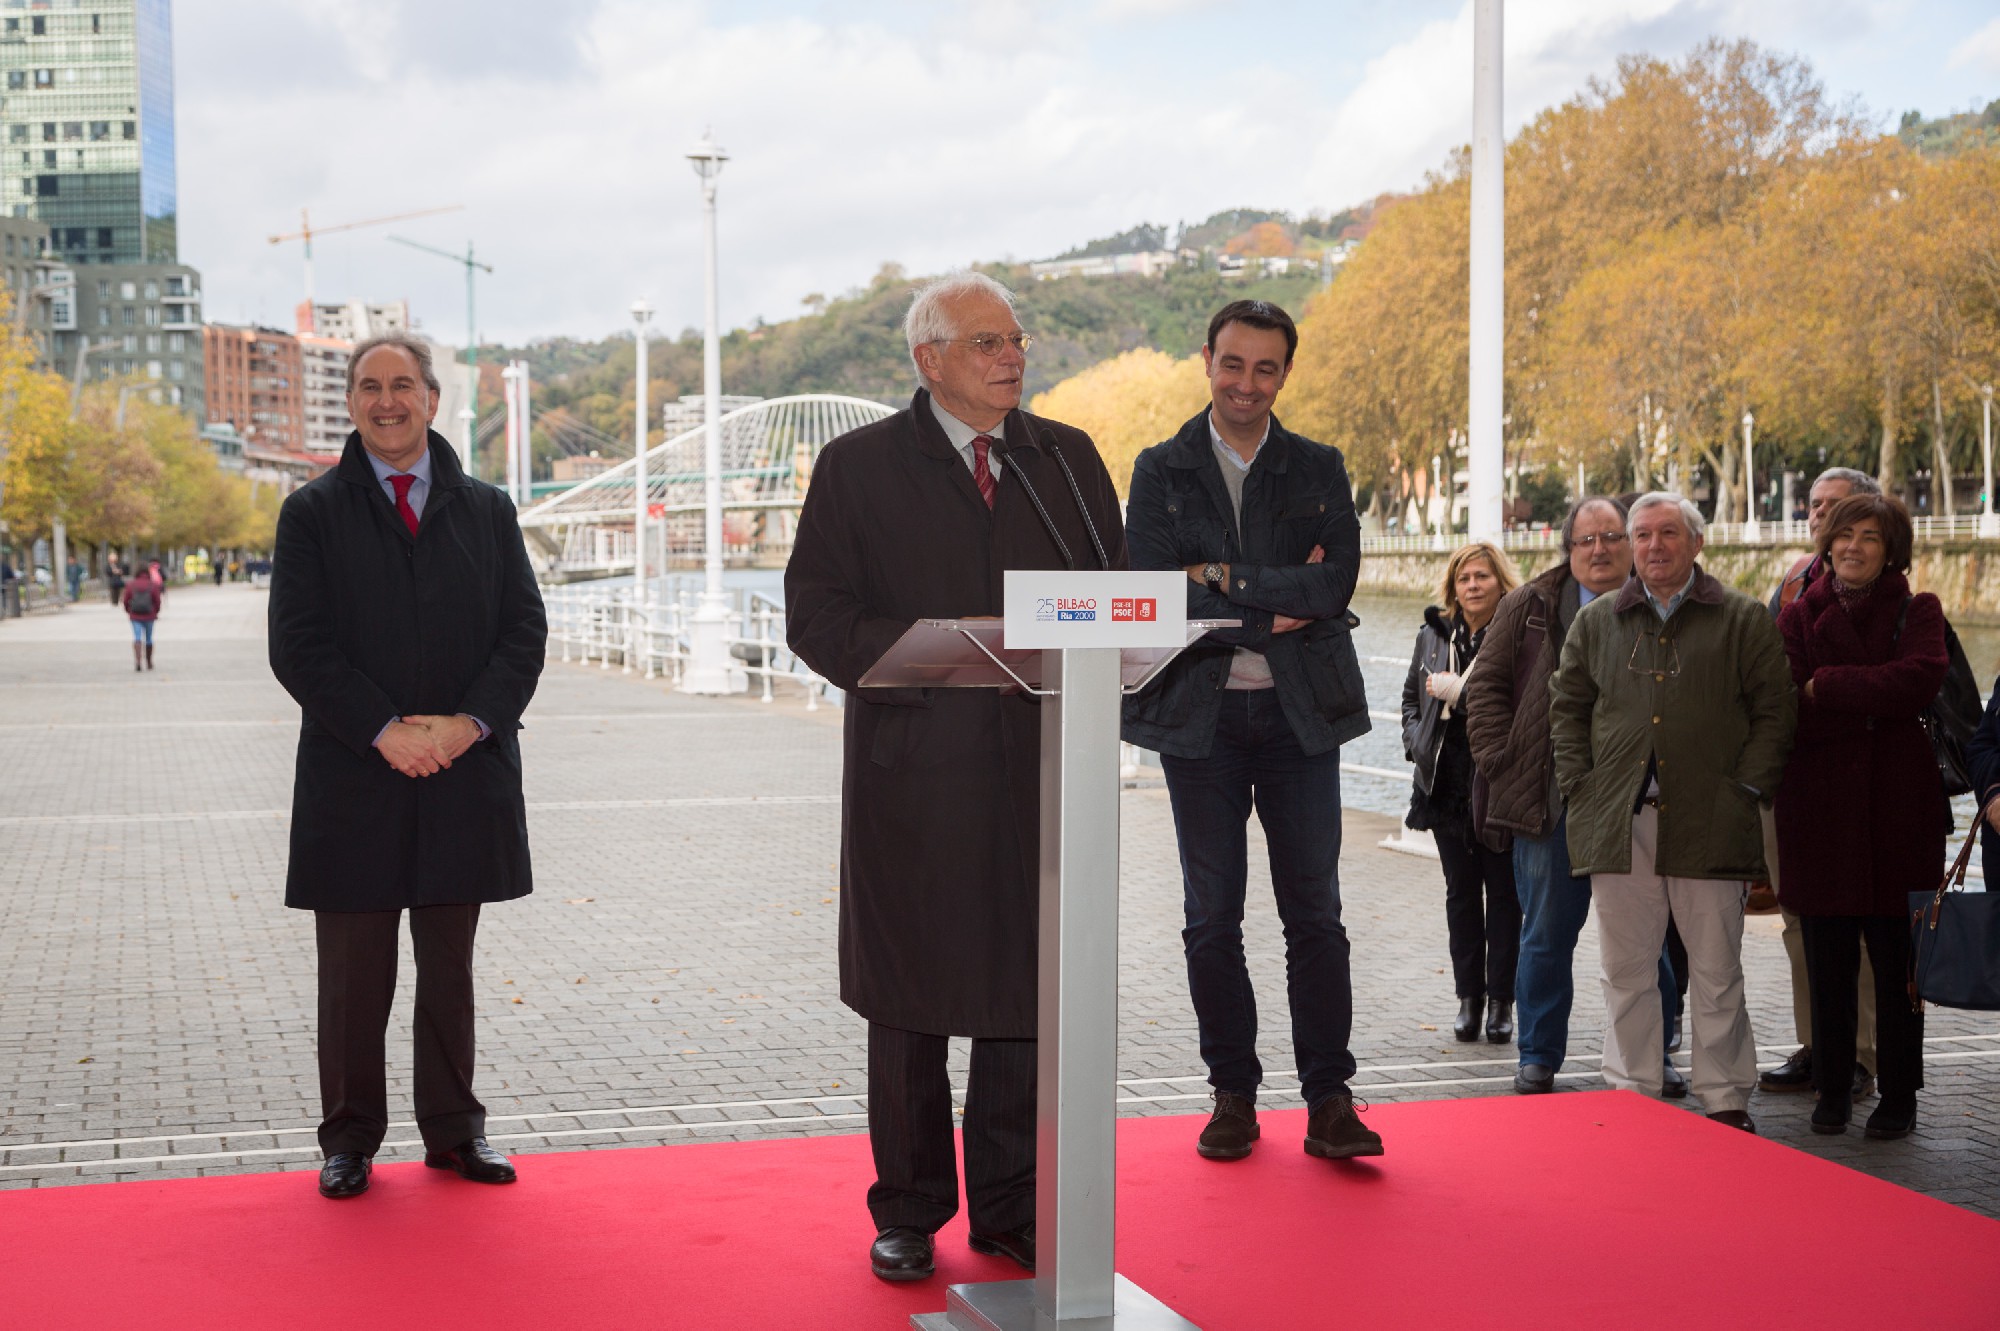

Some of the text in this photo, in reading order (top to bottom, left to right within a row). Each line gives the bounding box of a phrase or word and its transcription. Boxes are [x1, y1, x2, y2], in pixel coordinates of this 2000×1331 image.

[1037, 599, 1055, 613] 25
[1057, 598, 1097, 610] BILBAO
[1075, 612, 1095, 620] 2000
